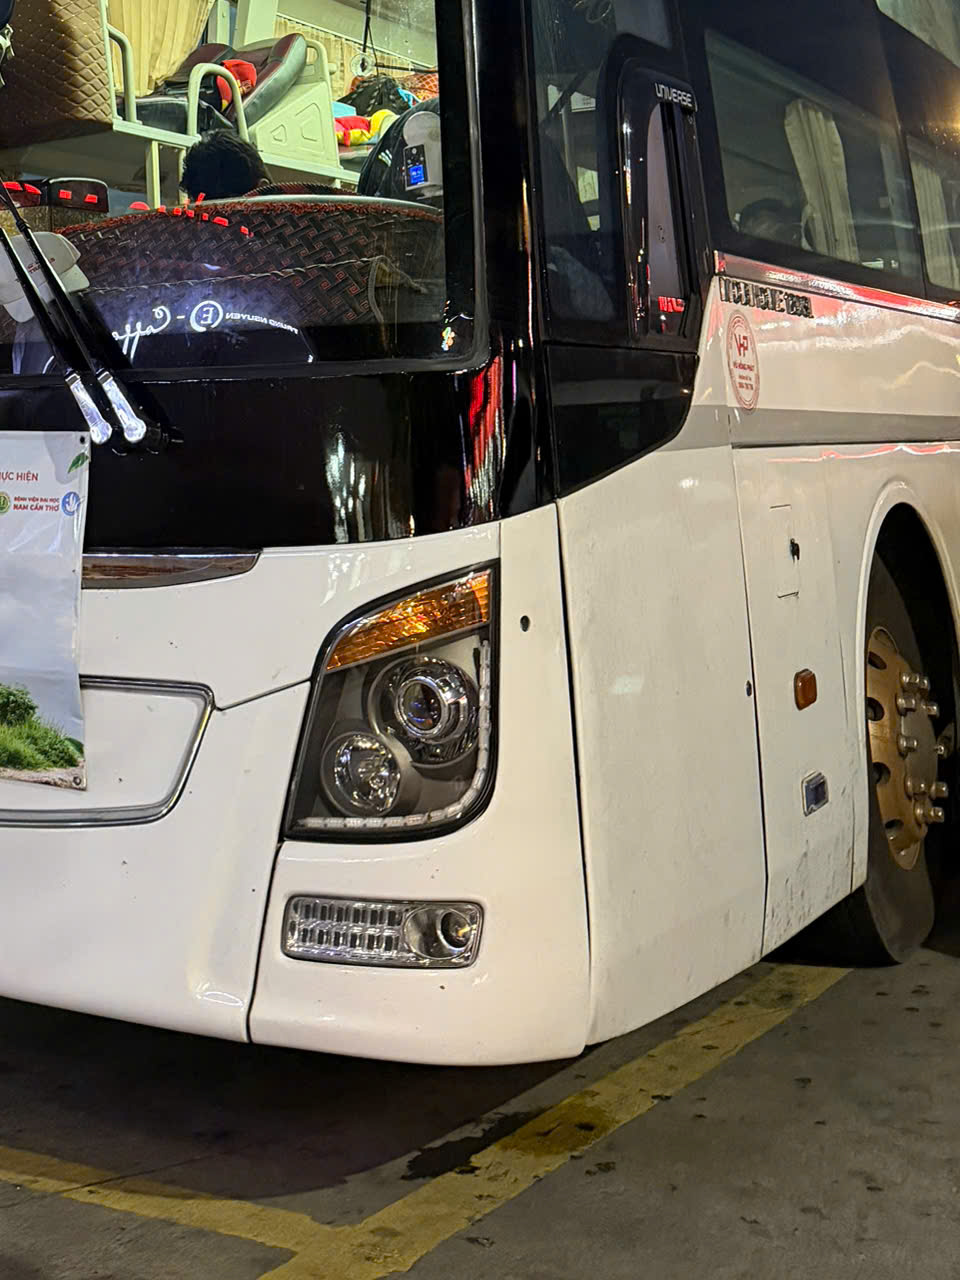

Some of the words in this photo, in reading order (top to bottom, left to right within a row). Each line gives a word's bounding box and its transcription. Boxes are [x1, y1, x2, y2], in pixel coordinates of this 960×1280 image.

[655, 82, 693, 107] UNIVERSE
[16, 470, 39, 483] HIỆN
[13, 503, 28, 511] NAM
